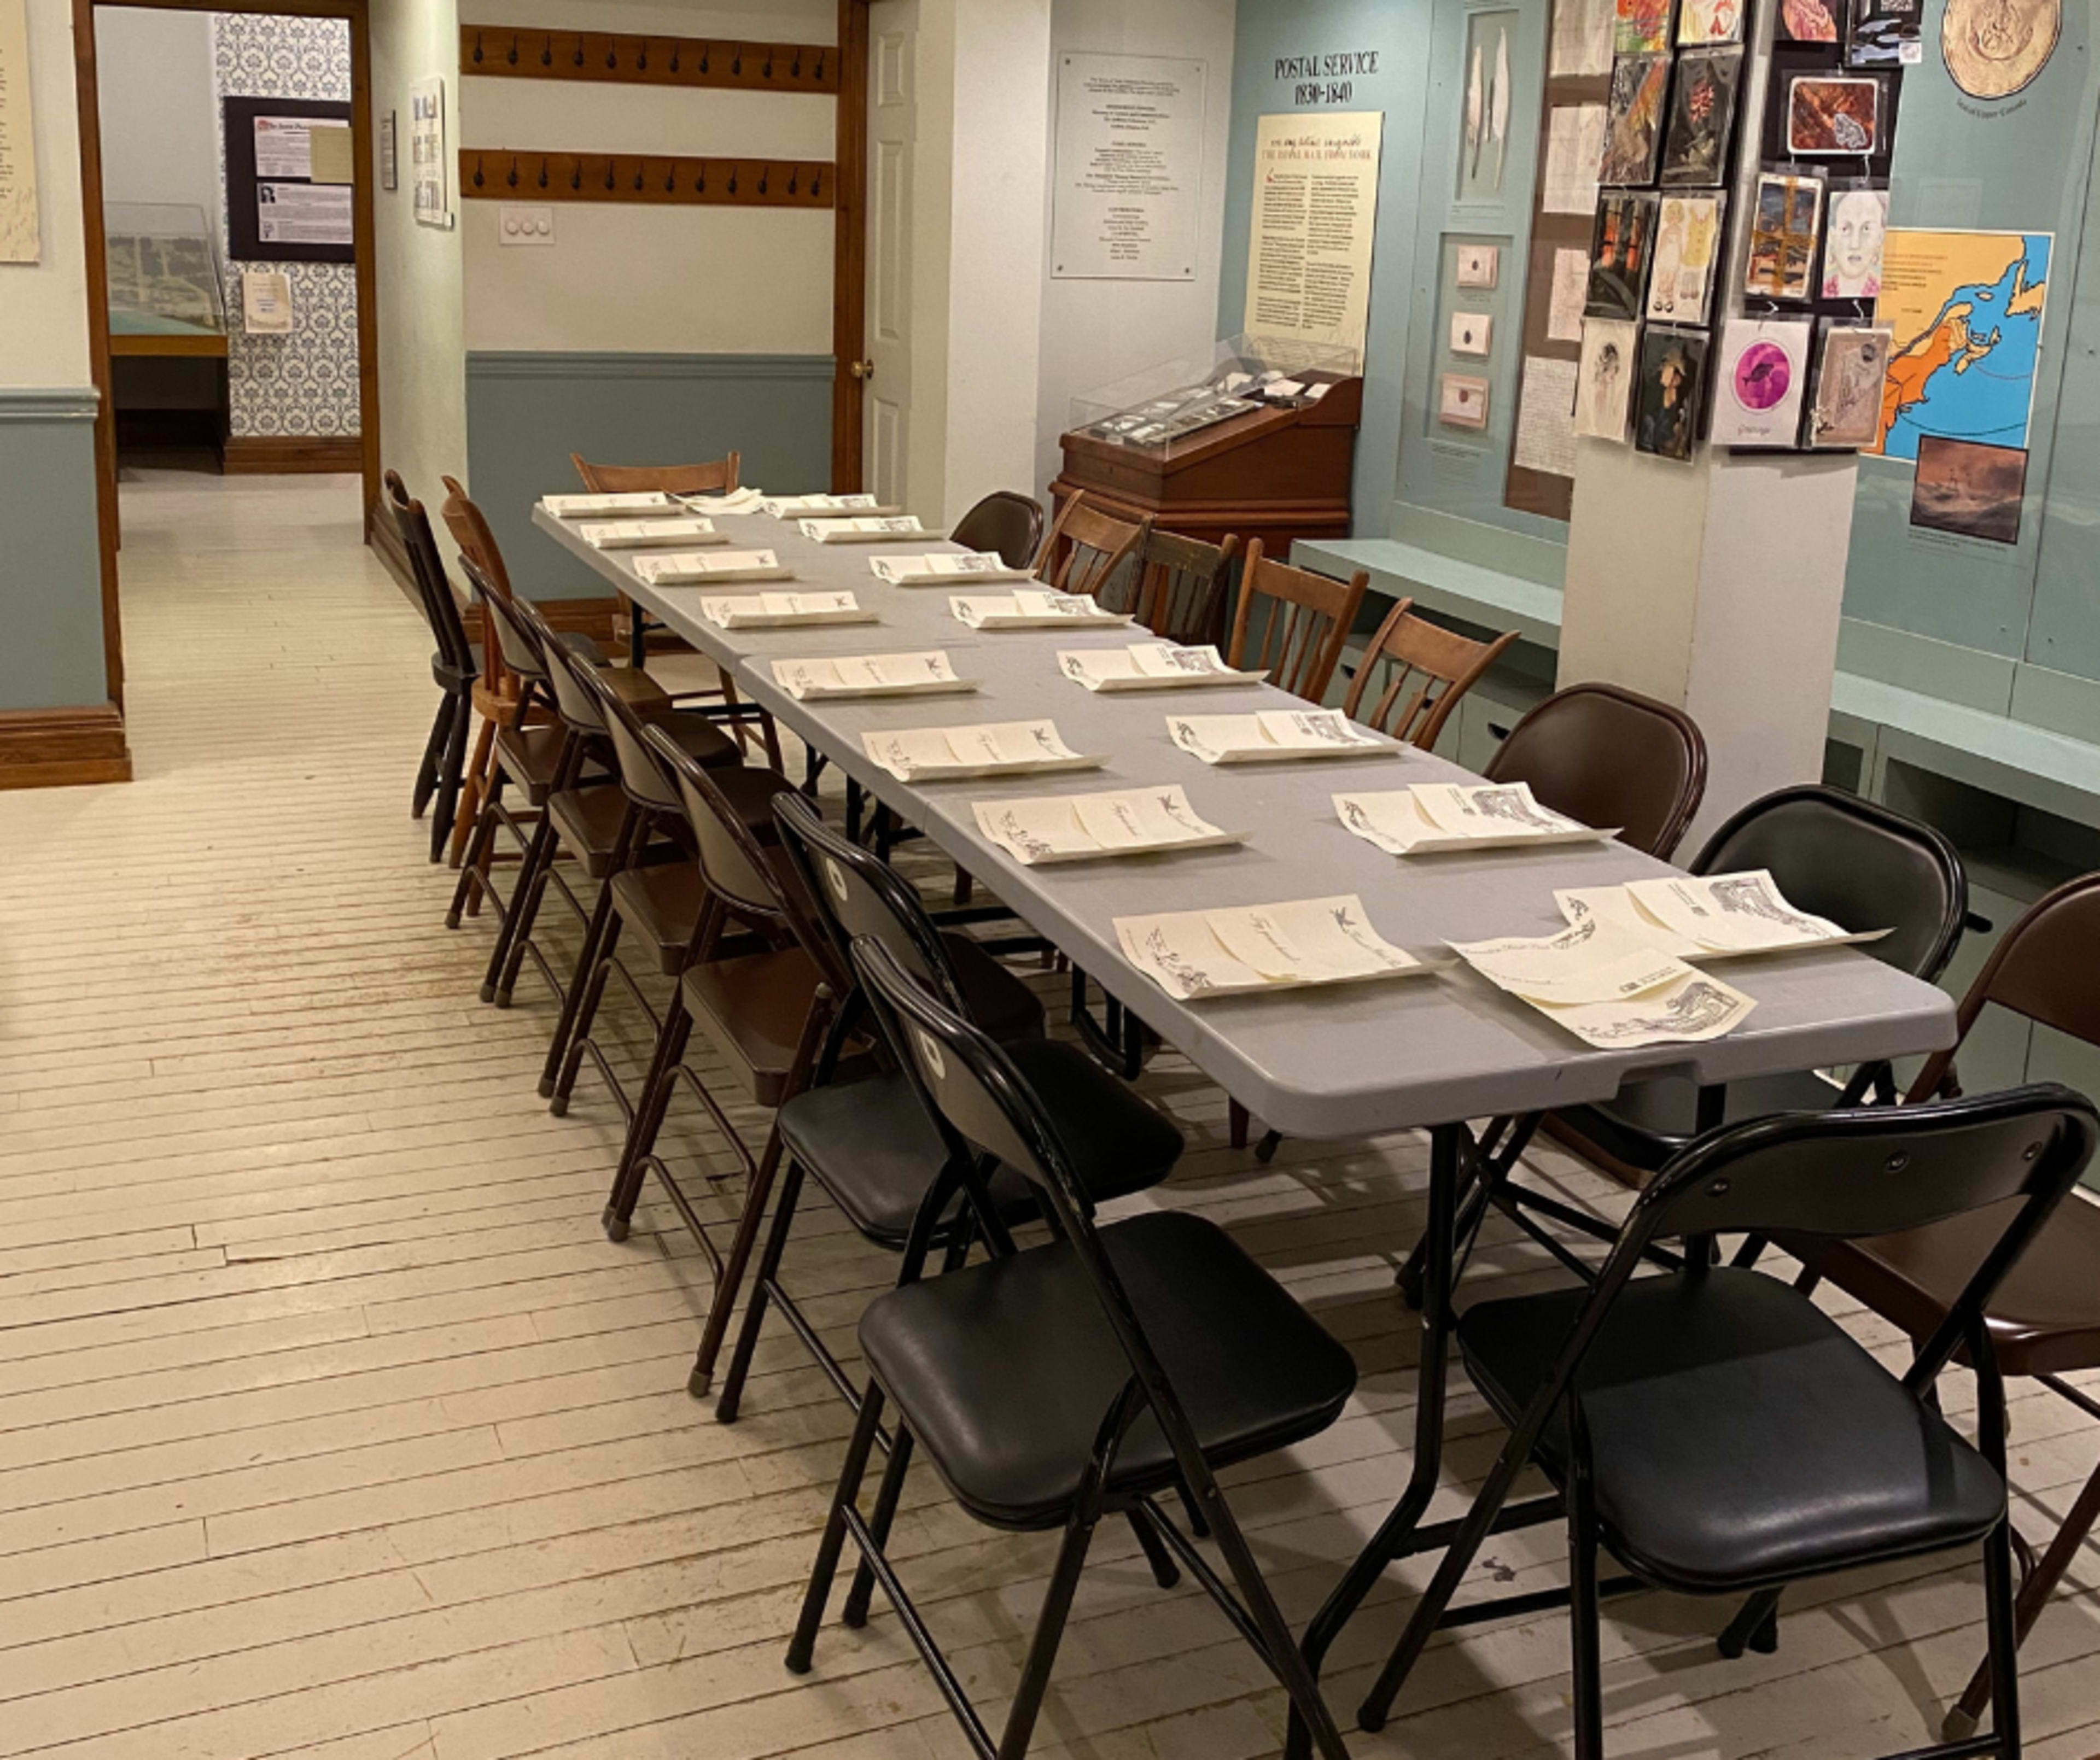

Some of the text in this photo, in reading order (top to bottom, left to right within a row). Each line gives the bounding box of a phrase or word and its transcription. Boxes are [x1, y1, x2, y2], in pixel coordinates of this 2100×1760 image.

[1275, 51, 1379, 80] POSTAL SERVICE
[1294, 80, 1352, 105] 1830-1840
